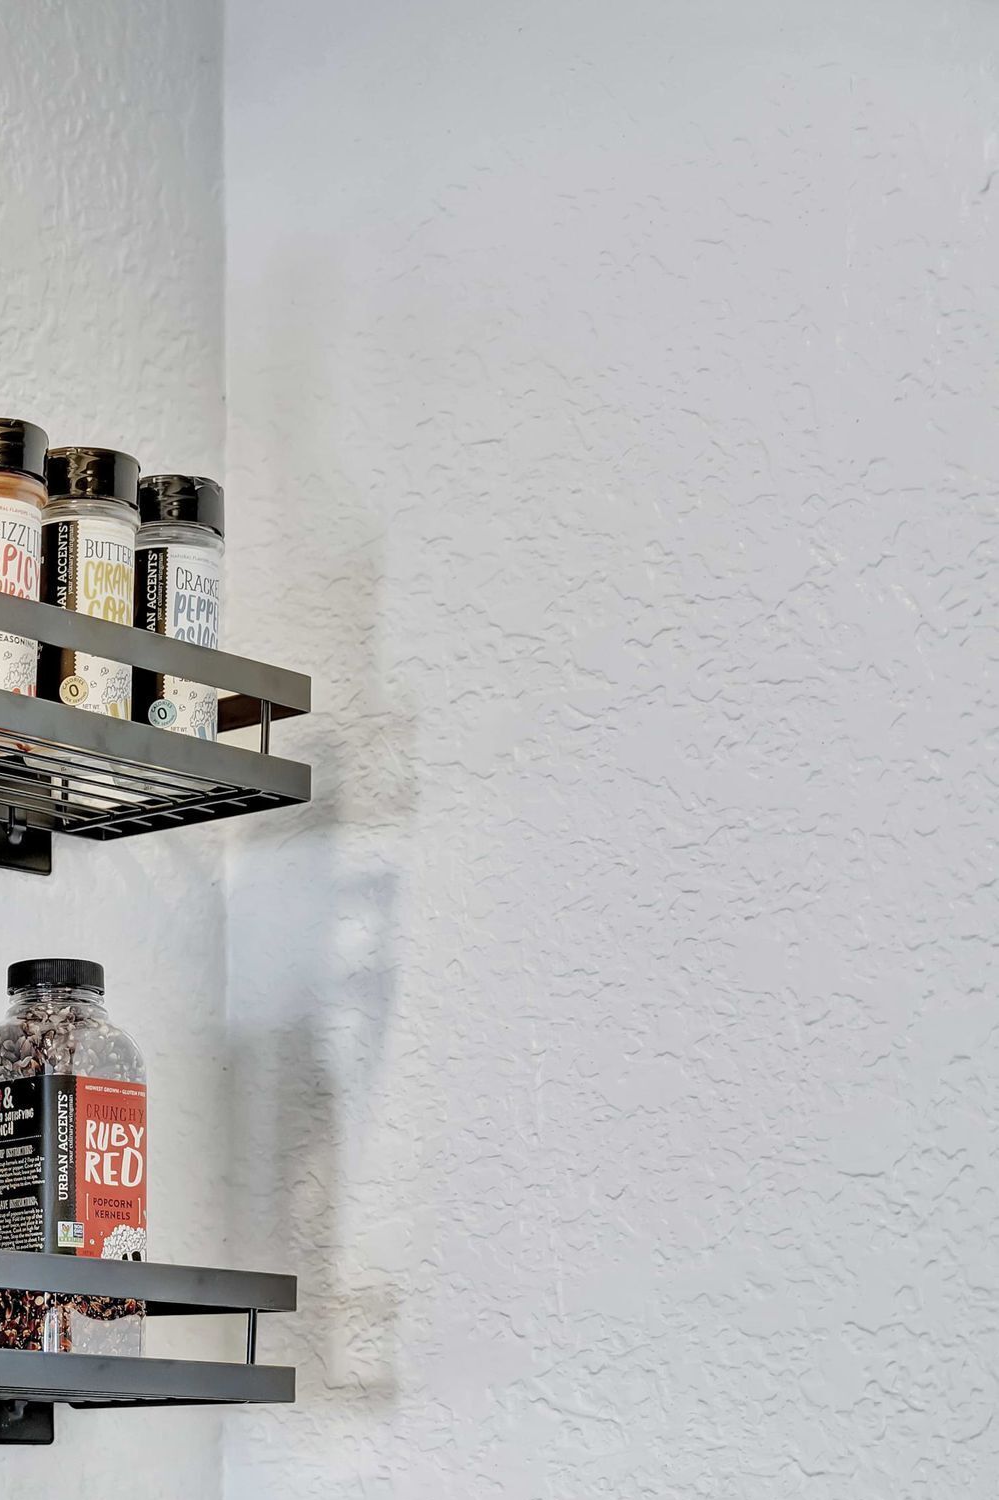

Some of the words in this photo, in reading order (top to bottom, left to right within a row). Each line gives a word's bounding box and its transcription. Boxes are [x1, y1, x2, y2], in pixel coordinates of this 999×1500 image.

[58, 525, 68, 583] ACCENTS
[147, 553, 157, 609] ACCENTS
[58, 1094, 68, 1152] ACCENTS
[86, 1103, 144, 1123] CRUNCHY
[86, 1119, 145, 1151] RUBY
[58, 1155, 68, 1201] URBAN
[85, 1146, 143, 1187] RED
[93, 1198, 132, 1208] POPCORN
[95, 1209, 130, 1220] KERNELS
